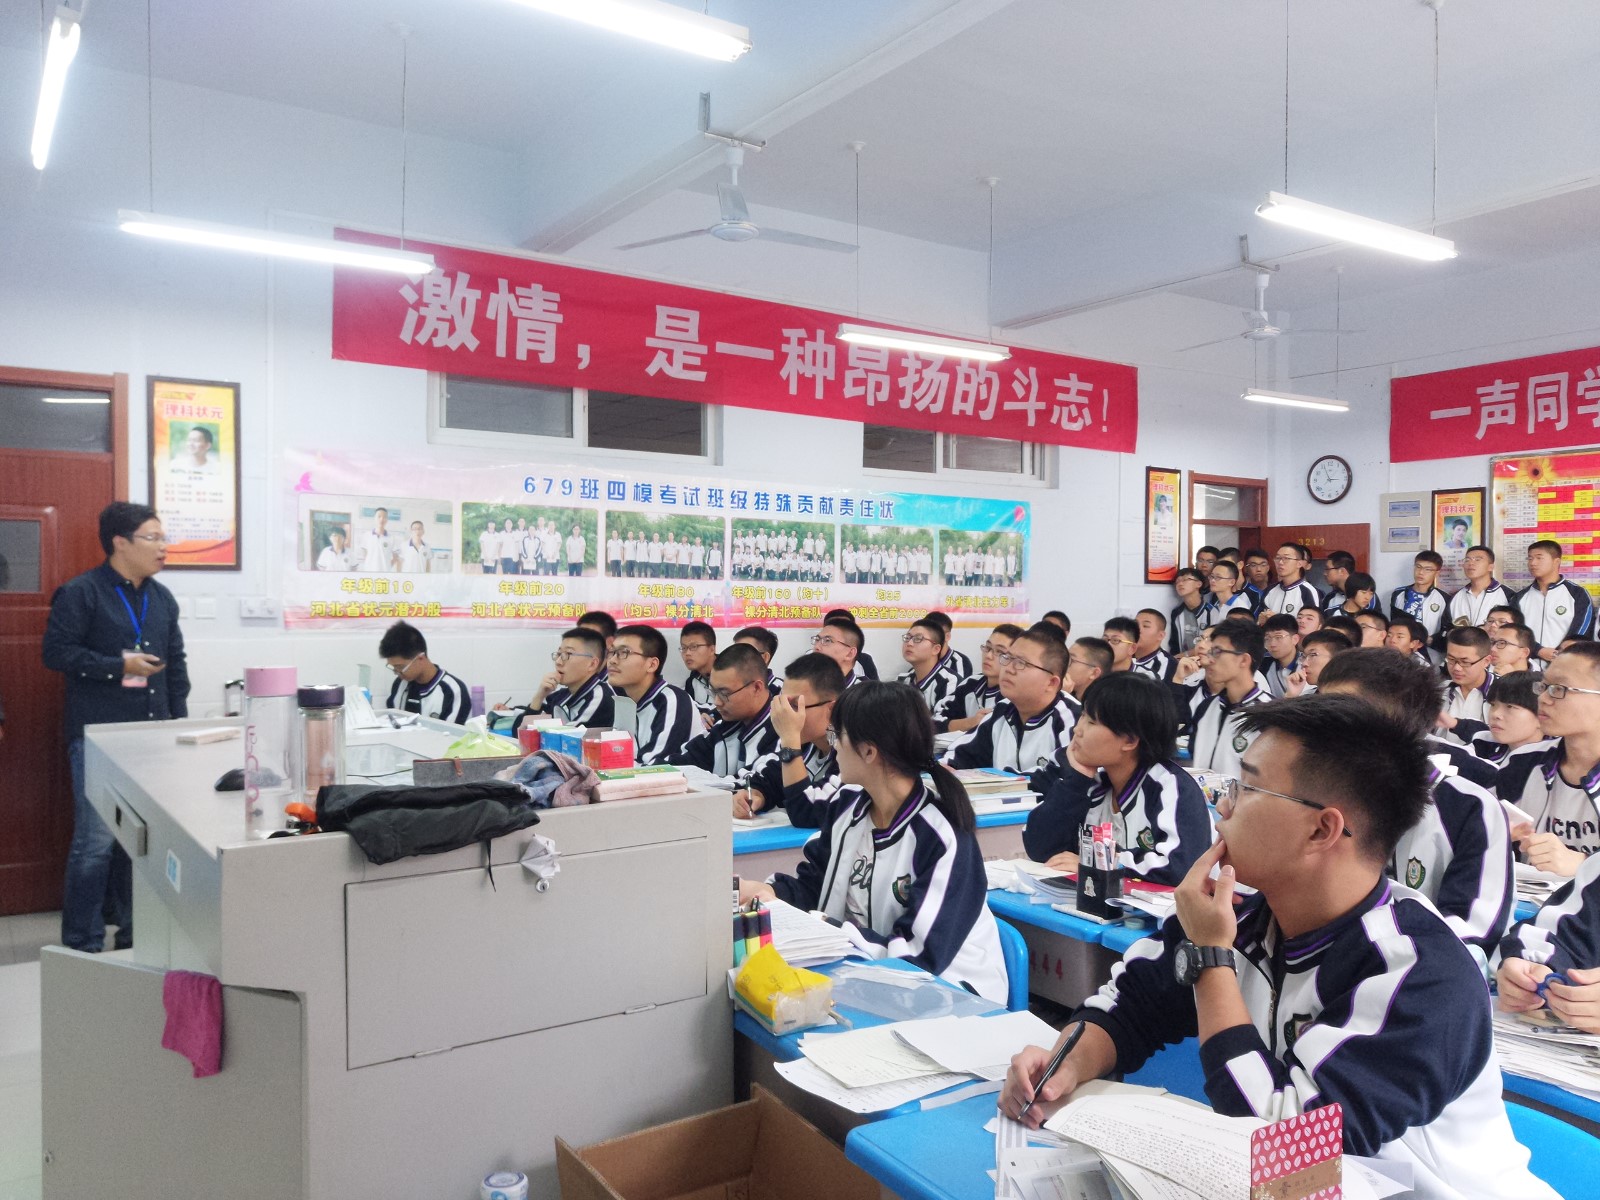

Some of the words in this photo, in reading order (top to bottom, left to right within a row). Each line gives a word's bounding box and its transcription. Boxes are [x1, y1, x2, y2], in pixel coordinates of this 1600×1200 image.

[524, 476, 894, 519] 679班四模考试班级特殊贡献责任状
[341, 578, 414, 594] 年级前10
[499, 581, 564, 596] 年级前20
[638, 582, 695, 598] 年级前80
[310, 601, 442, 617] 河北省状元潜力股
[472, 602, 587, 618] 河北省状元预备队
